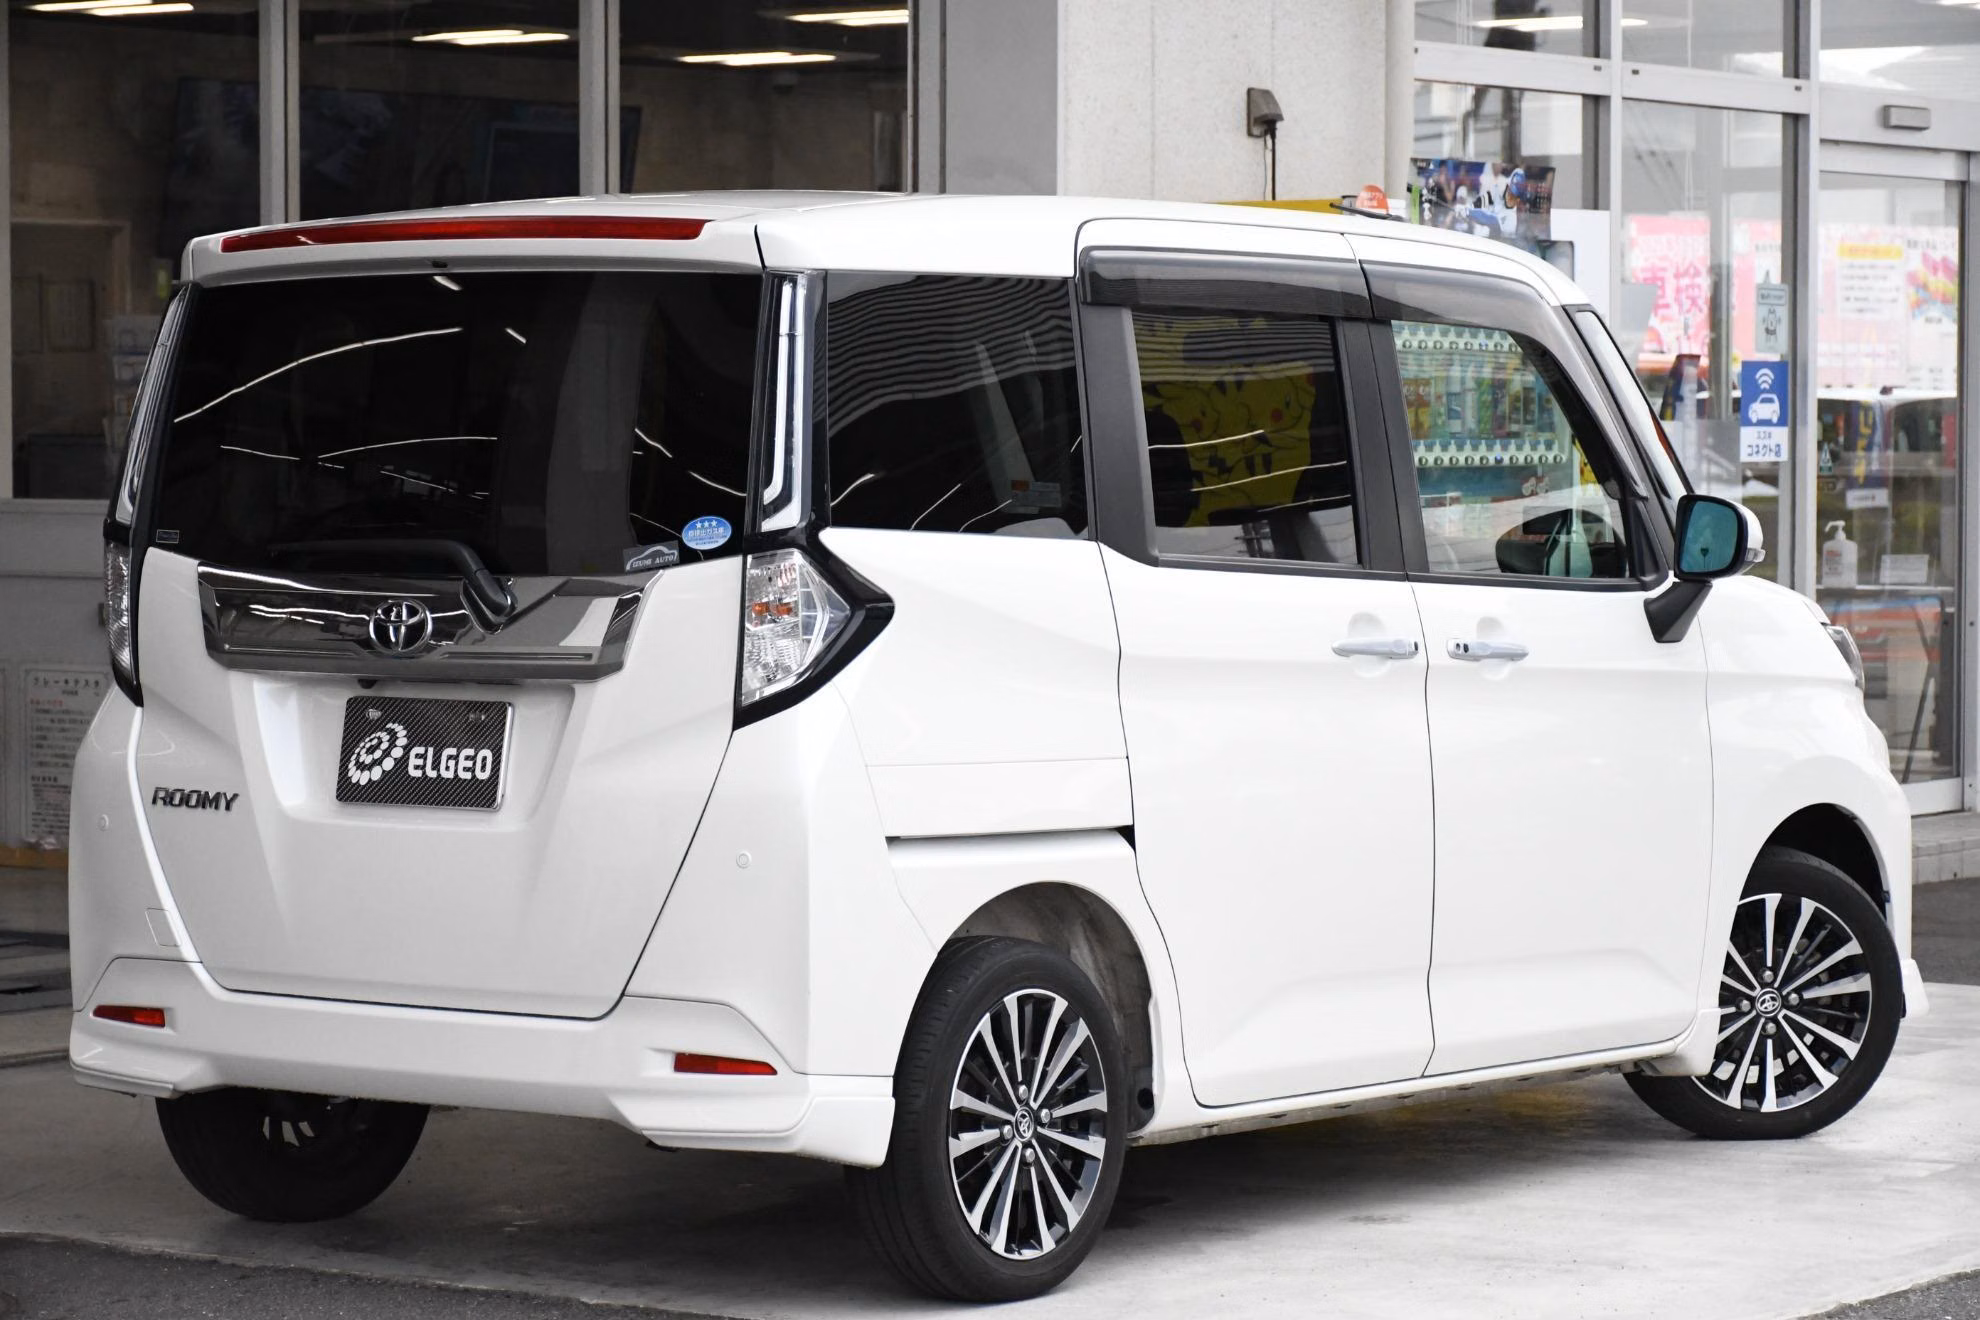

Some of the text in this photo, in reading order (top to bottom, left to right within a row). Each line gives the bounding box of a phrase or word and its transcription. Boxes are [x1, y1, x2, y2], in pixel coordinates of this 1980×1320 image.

[1747, 443, 1782, 458] コネクト店
[654, 554, 674, 565] AUTO
[408, 746, 493, 780] ELGEO
[151, 786, 240, 812] ROOMY
